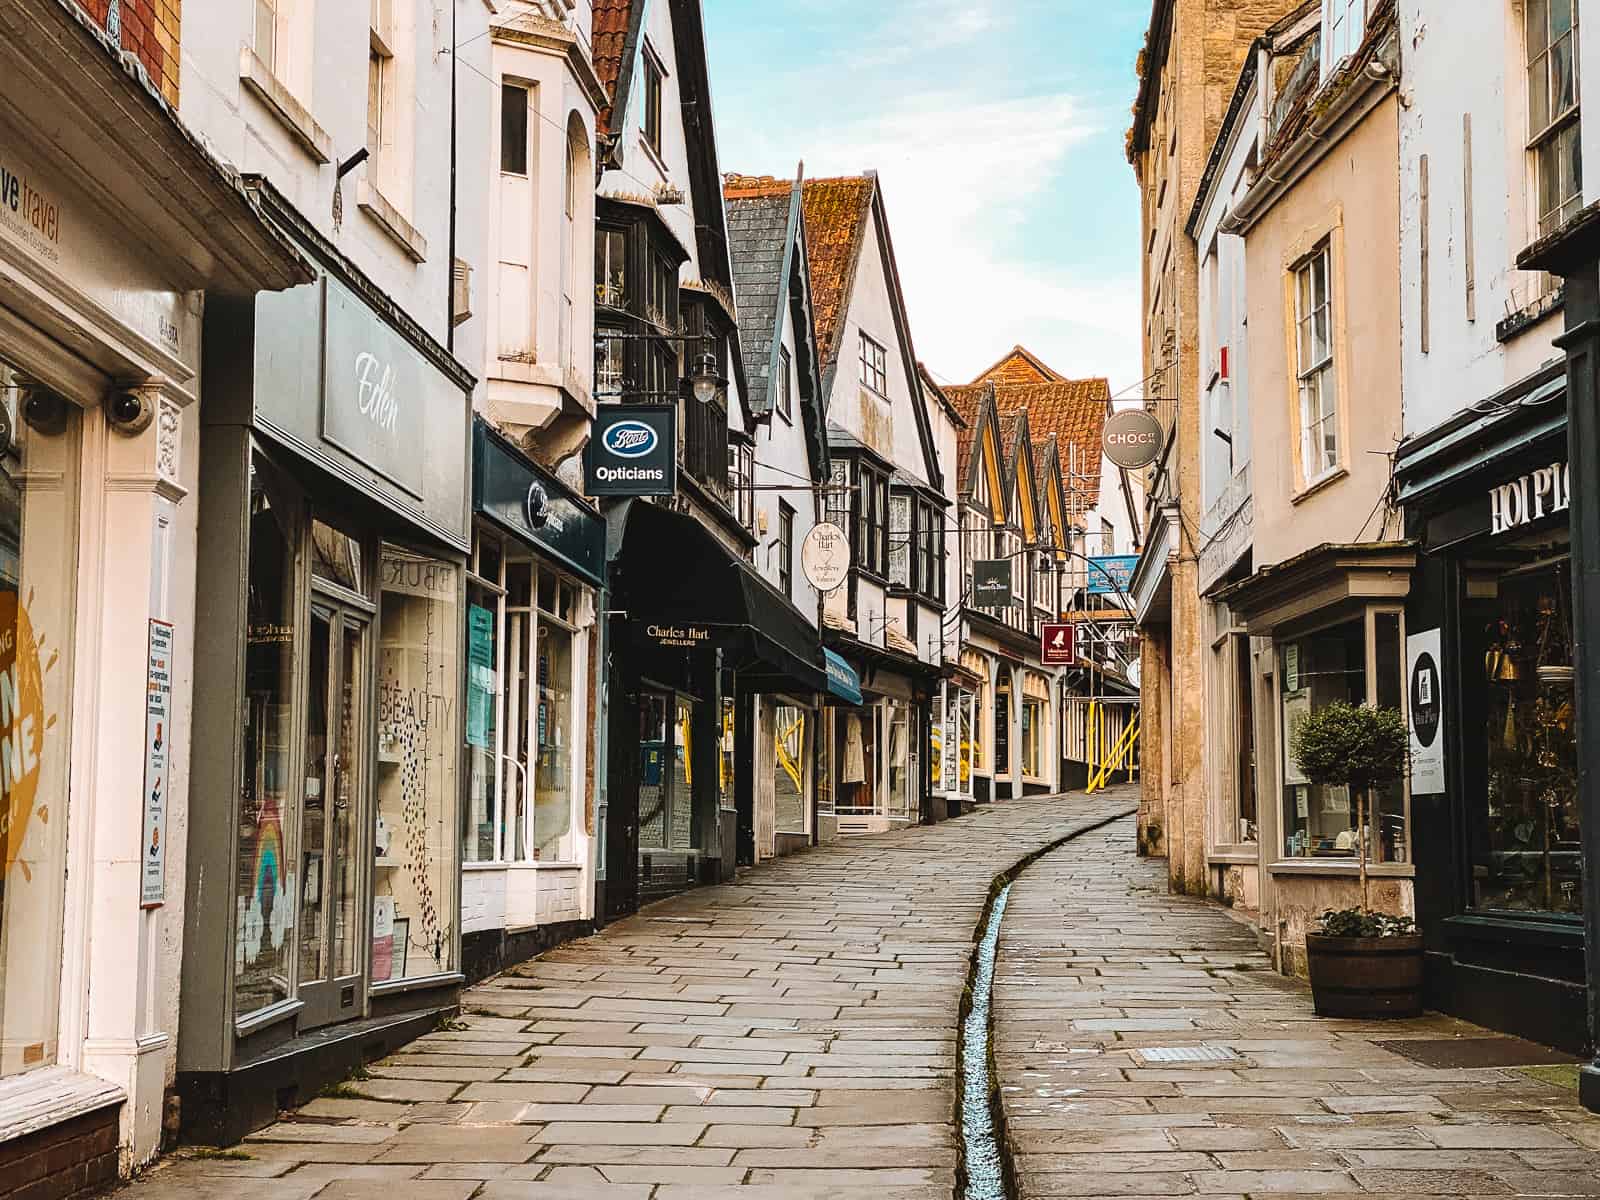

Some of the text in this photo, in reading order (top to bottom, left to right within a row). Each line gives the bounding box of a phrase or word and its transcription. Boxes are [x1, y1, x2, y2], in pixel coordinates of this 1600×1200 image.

[22, 176, 60, 244] travel
[355, 352, 399, 432] Eden
[611, 429, 649, 449] Boots
[1107, 433, 1148, 444] CHOC
[596, 466, 663, 482] Opticians
[1488, 476, 1531, 536] HOI
[646, 624, 711, 640] Charles Hart
[659, 638, 696, 647] JEWELLERS
[379, 686, 453, 731] BEAUTY
